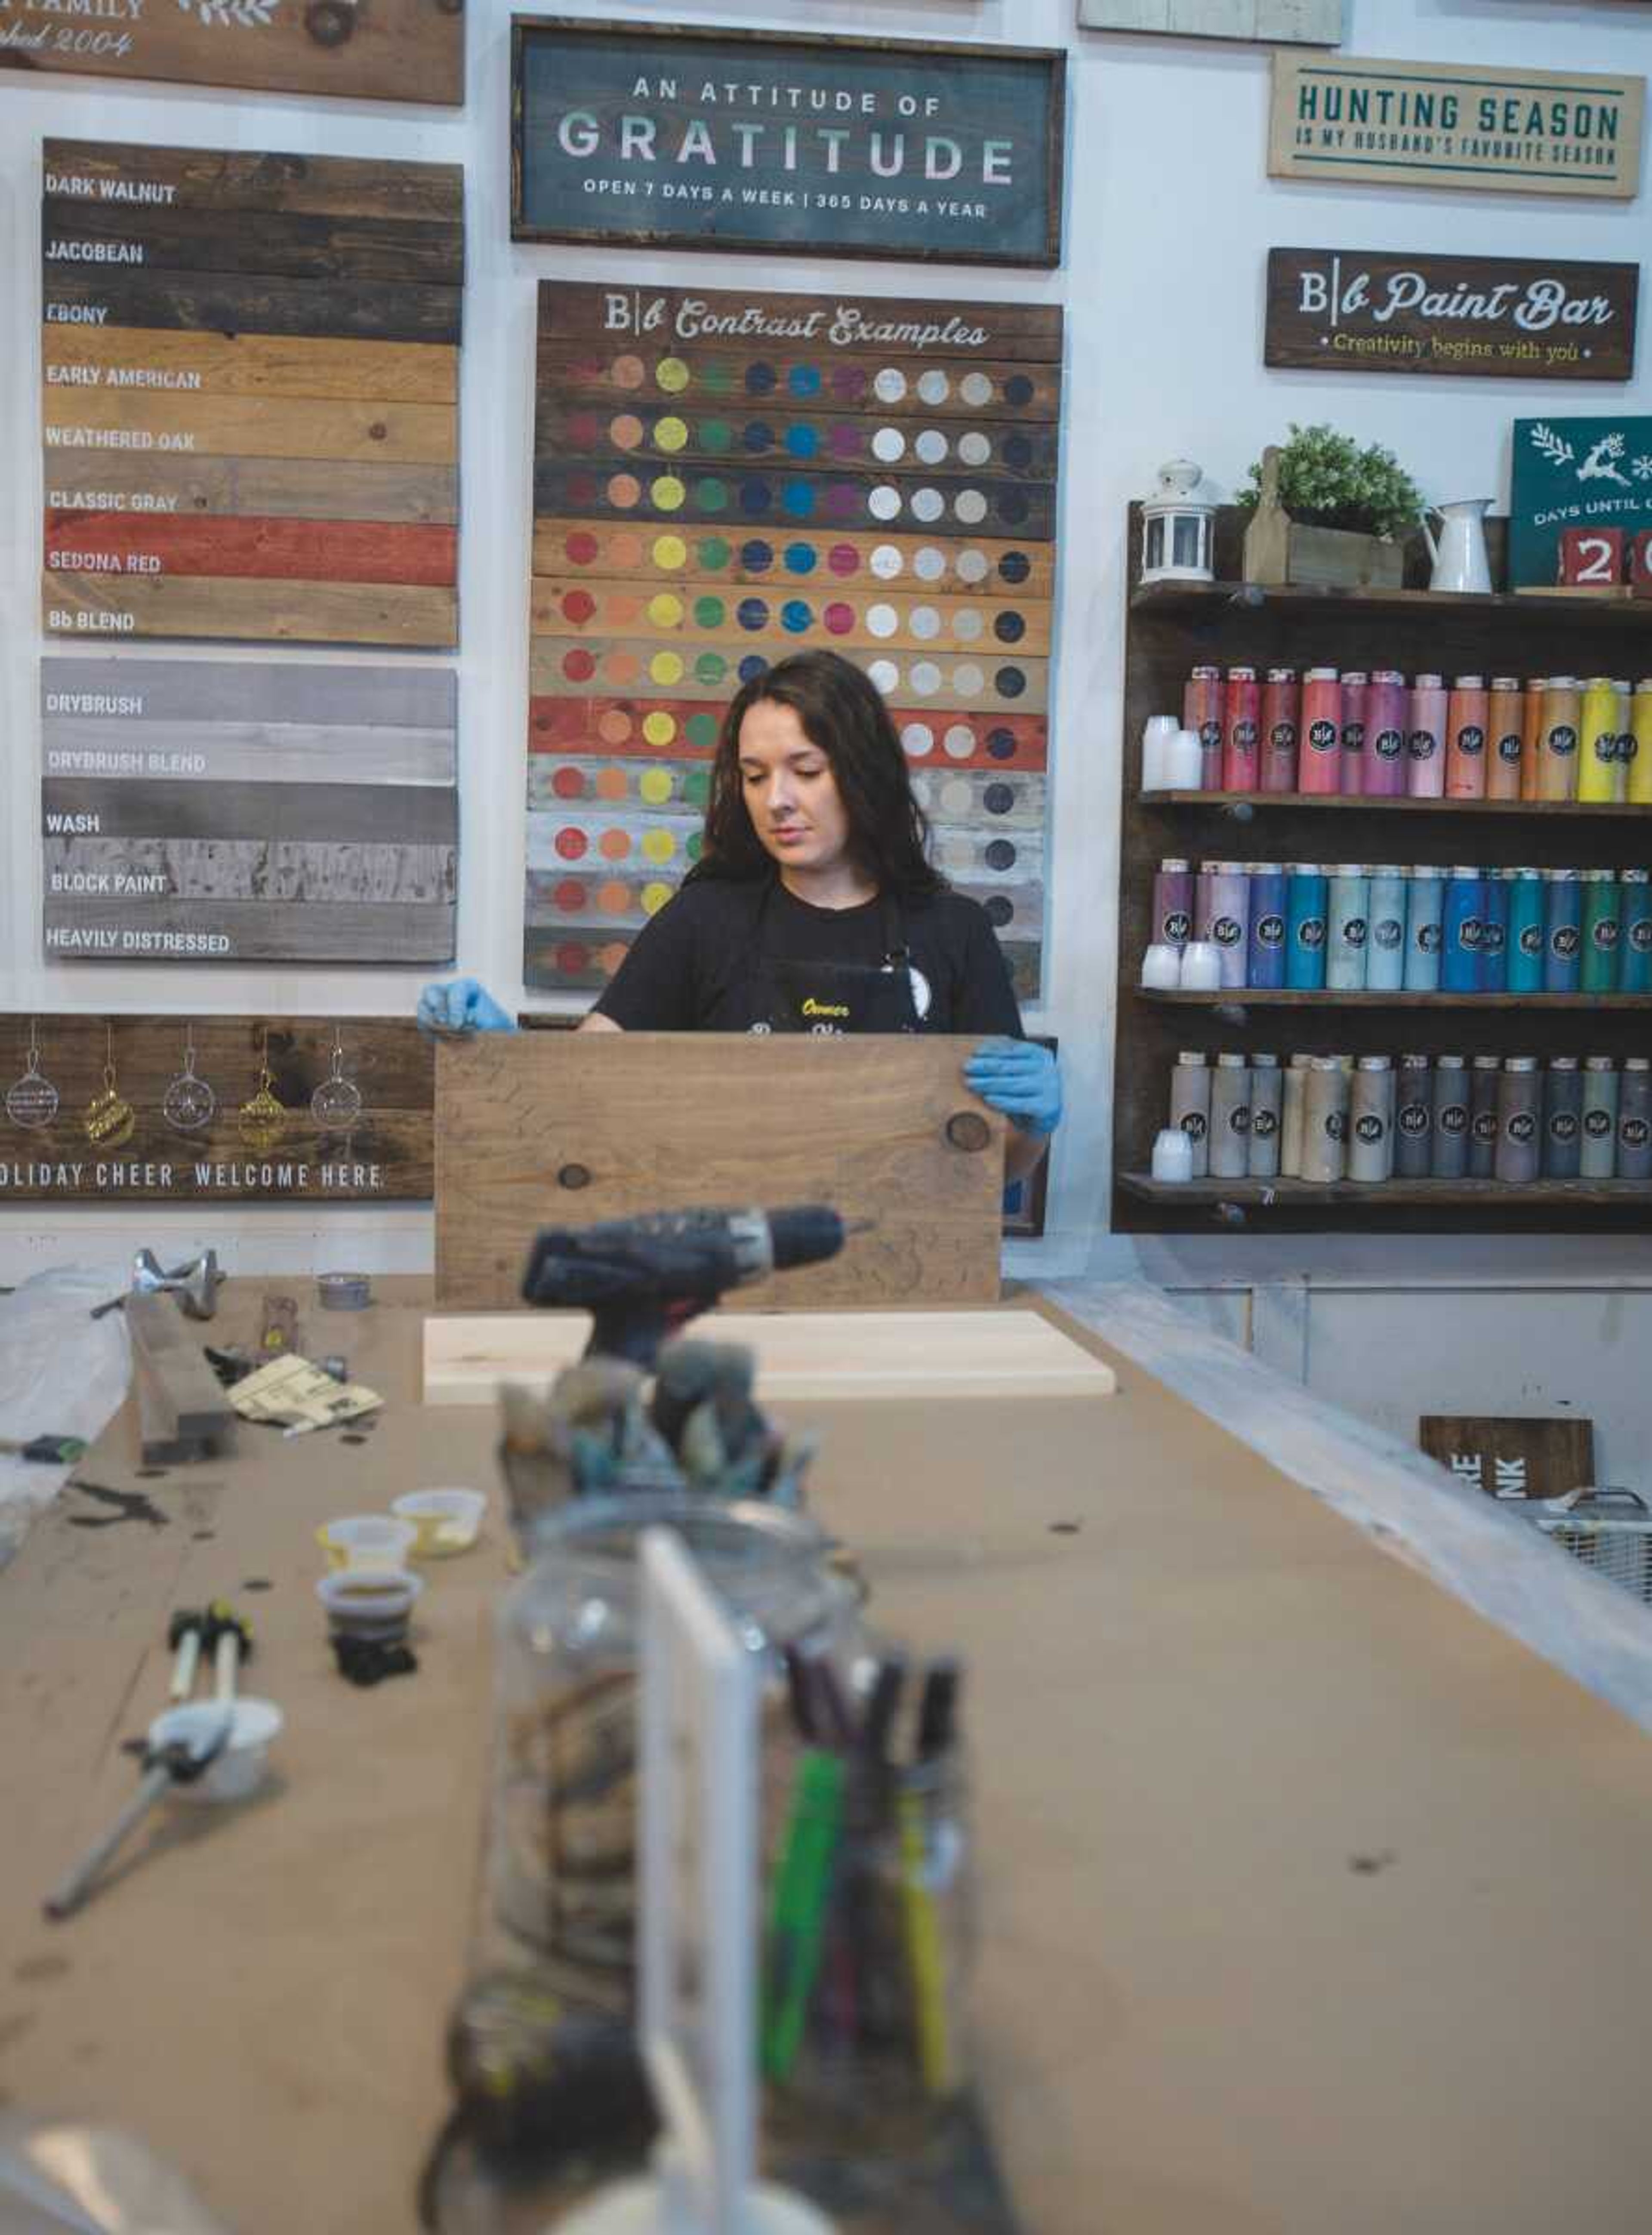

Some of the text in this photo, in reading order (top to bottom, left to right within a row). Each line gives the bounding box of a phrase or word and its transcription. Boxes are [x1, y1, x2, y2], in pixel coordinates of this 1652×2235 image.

[633, 78, 940, 116] AN ATTITUDE OF
[1299, 85, 1618, 140] HUNTING SEASON
[559, 112, 1013, 184] GRATITUDE
[1296, 127, 1615, 165] IS MY HUSBAND'S FAVORITE SEASON
[46, 174, 176, 203] DARK WALNUT
[583, 179, 985, 218] OPEN 7 DAYS A WEEK 365 DAYS A YEAR
[45, 241, 143, 263] JACOBEAN
[1373, 272, 1519, 322] Paint
[1514, 280, 1615, 330] Bar
[47, 304, 108, 324] EBONY
[676, 299, 826, 338] Contrast
[829, 305, 989, 349] Examples
[1334, 333, 1578, 365] Creativity begins with you
[47, 365, 201, 388] EARLY AMERICAN
[46, 427, 195, 450] WEATHERED OAK
[50, 491, 179, 512] CLASSIC GRAY
[1534, 505, 1580, 526] DAYS
[1586, 498, 1640, 514] UNTIL
[50, 551, 161, 573] SEDONA RED
[1577, 538, 1612, 582] 2
[49, 610, 135, 630] Bb BLEND
[46, 694, 143, 715] DRYBRUSH
[48, 751, 206, 773] DRYBRUSH BLEND
[47, 814, 100, 832] WASH
[52, 874, 166, 893] BLOCK PAINT
[46, 928, 229, 952] HEAVILY DISTRESSED
[0, 1162, 82, 1186] OLIDAY
[96, 1163, 172, 1186] CHEER
[195, 1162, 309, 1187] WELCOME
